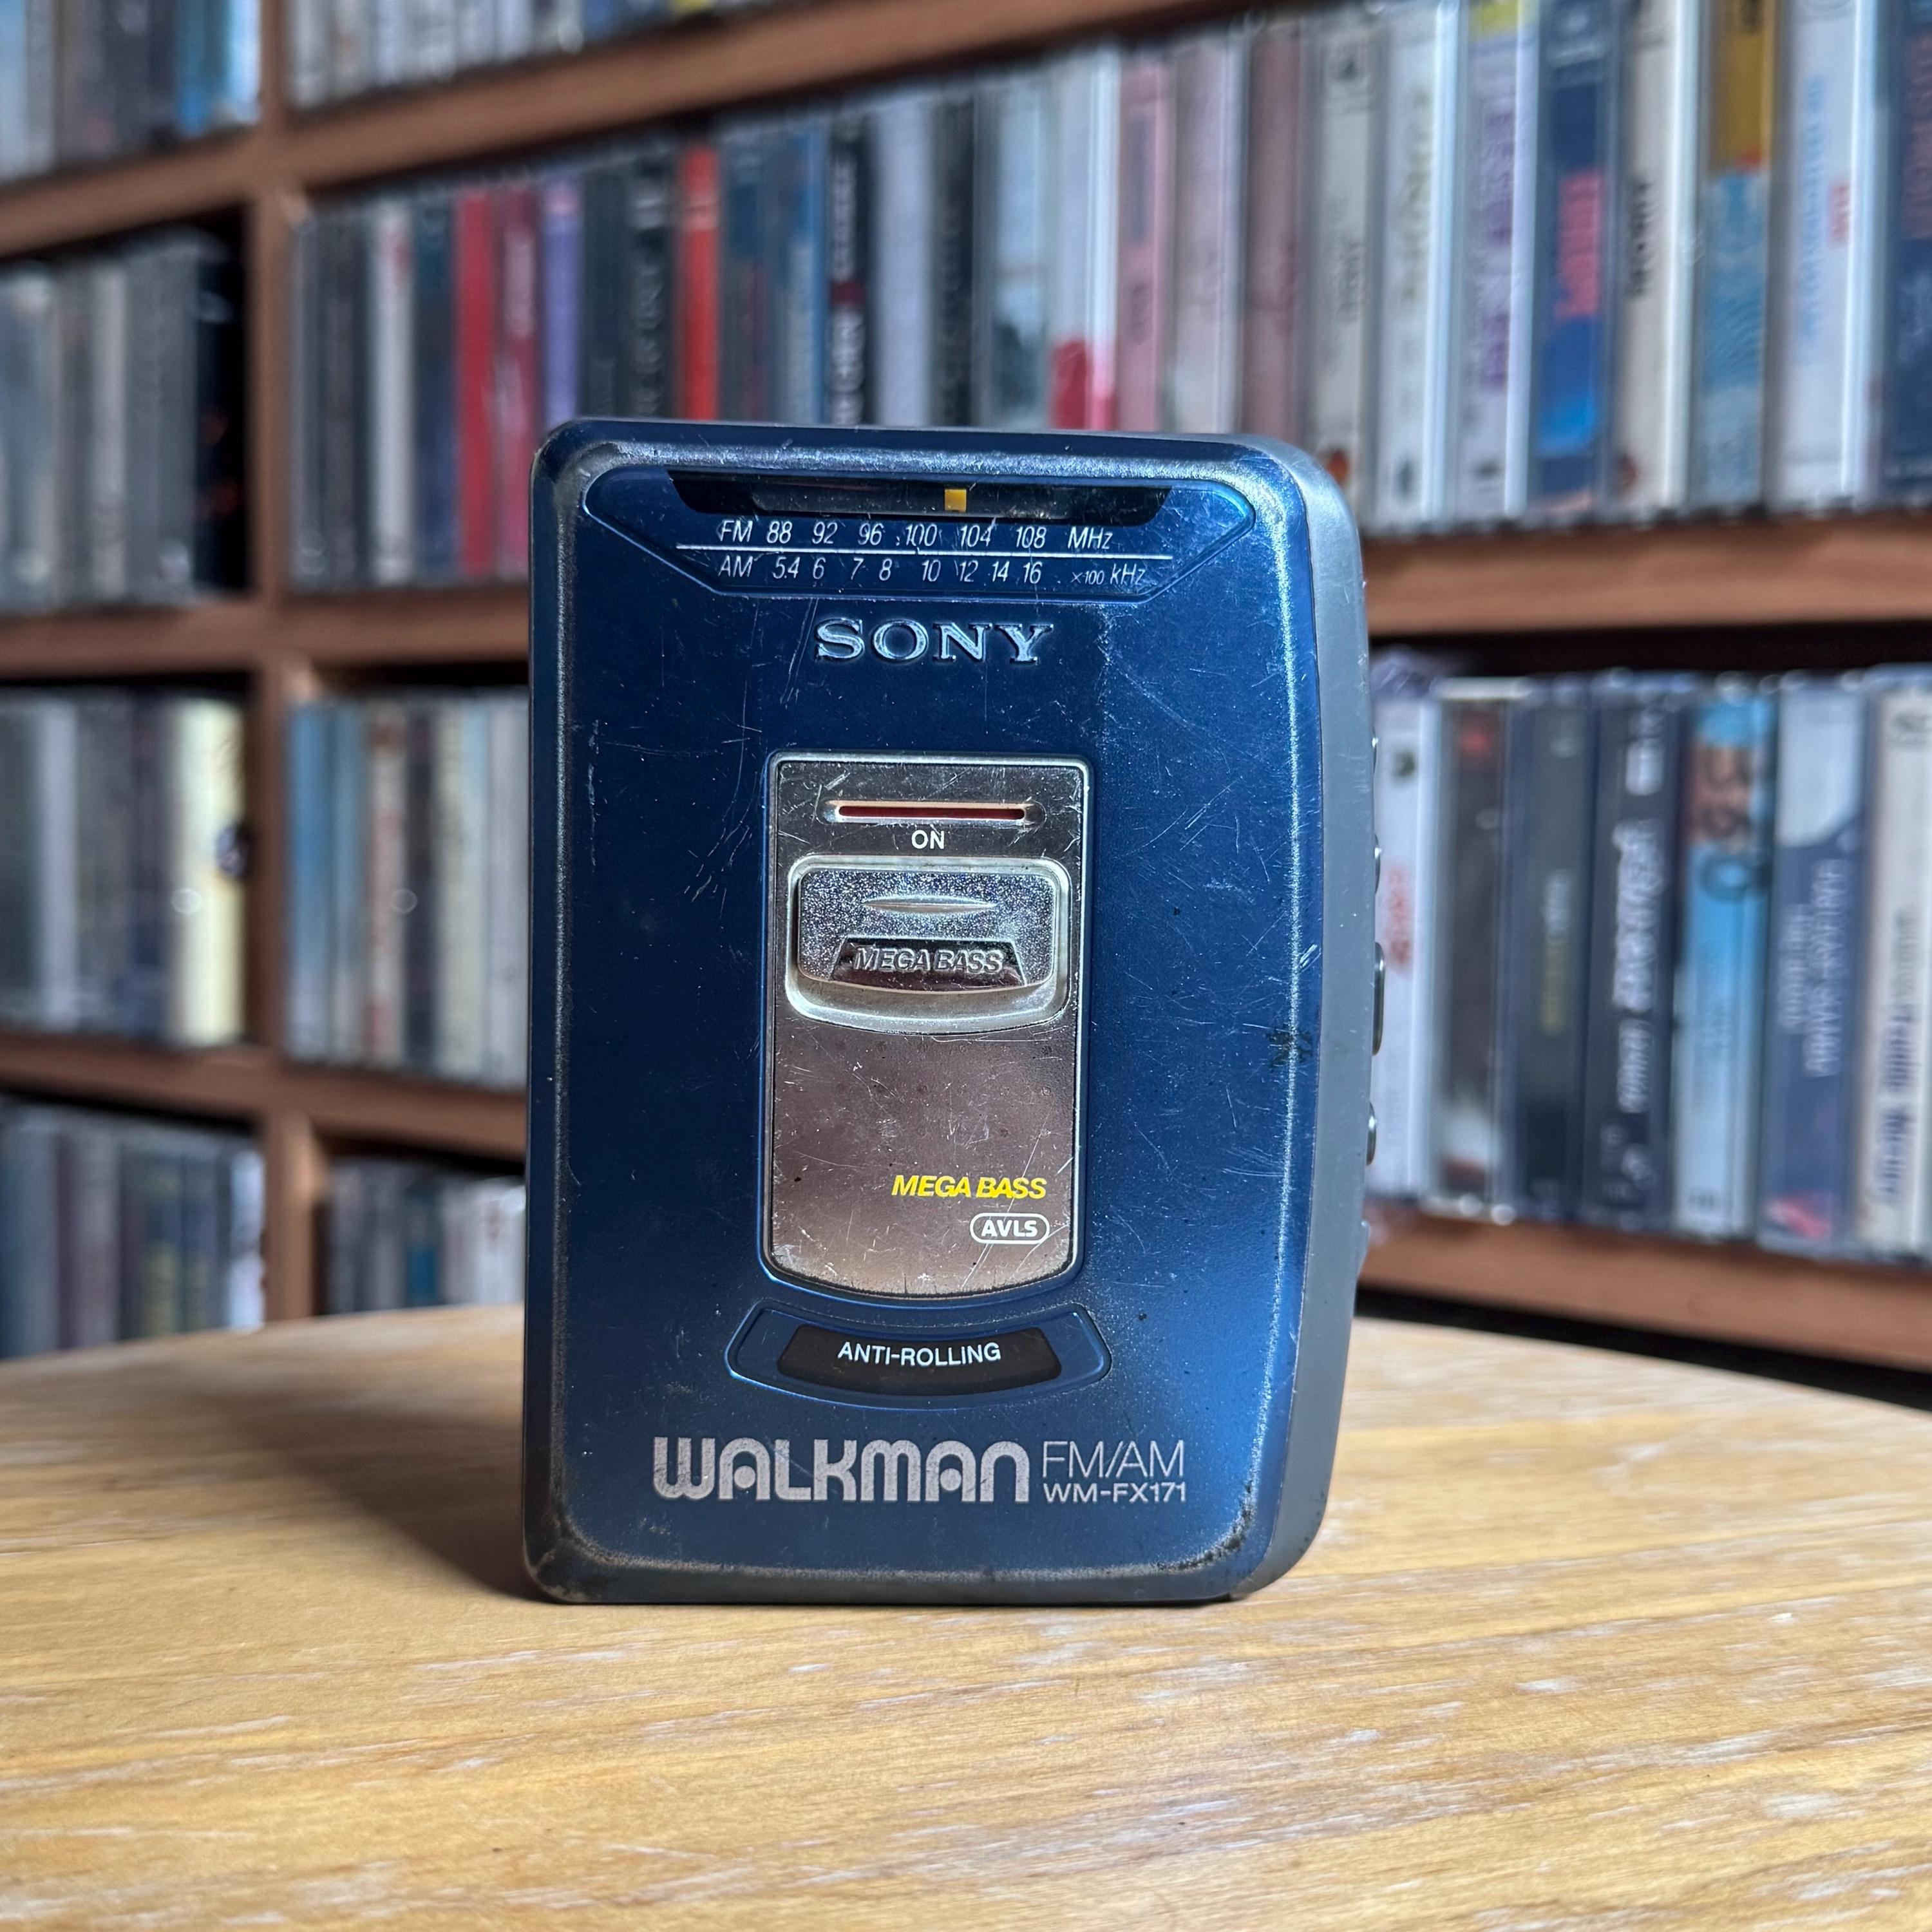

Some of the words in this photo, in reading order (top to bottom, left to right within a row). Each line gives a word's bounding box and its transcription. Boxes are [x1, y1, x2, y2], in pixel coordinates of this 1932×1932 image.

[719, 520, 753, 542] FM
[766, 521, 792, 544] 88
[811, 522, 838, 544] 92
[858, 523, 883, 545] 96
[906, 524, 938, 547] 100
[959, 524, 992, 547] 104
[1016, 526, 1046, 549] 108
[1068, 527, 1113, 549] MHz
[718, 555, 753, 577] AM
[773, 556, 800, 578] 5.4
[851, 557, 864, 580] 7
[878, 558, 893, 581] 8
[921, 560, 942, 582] 10
[959, 561, 978, 582] 12
[992, 562, 1010, 582] 14
[1023, 562, 1042, 584] 16
[815, 618, 1054, 663] SONY
[911, 830, 945, 849] ON
[853, 948, 931, 971] MEGA
[933, 949, 1004, 972] BASS
[891, 1175, 971, 1198] MEGA
[976, 1177, 1047, 1198] BASS
[981, 1220, 1037, 1237] AVLS
[838, 1341, 1001, 1366] ANTI-ROLLING
[653, 1436, 1030, 1502] WALKMAN
[1043, 1439, 1184, 1478] FM/AM
[1043, 1482, 1186, 1503] WM-FX171
